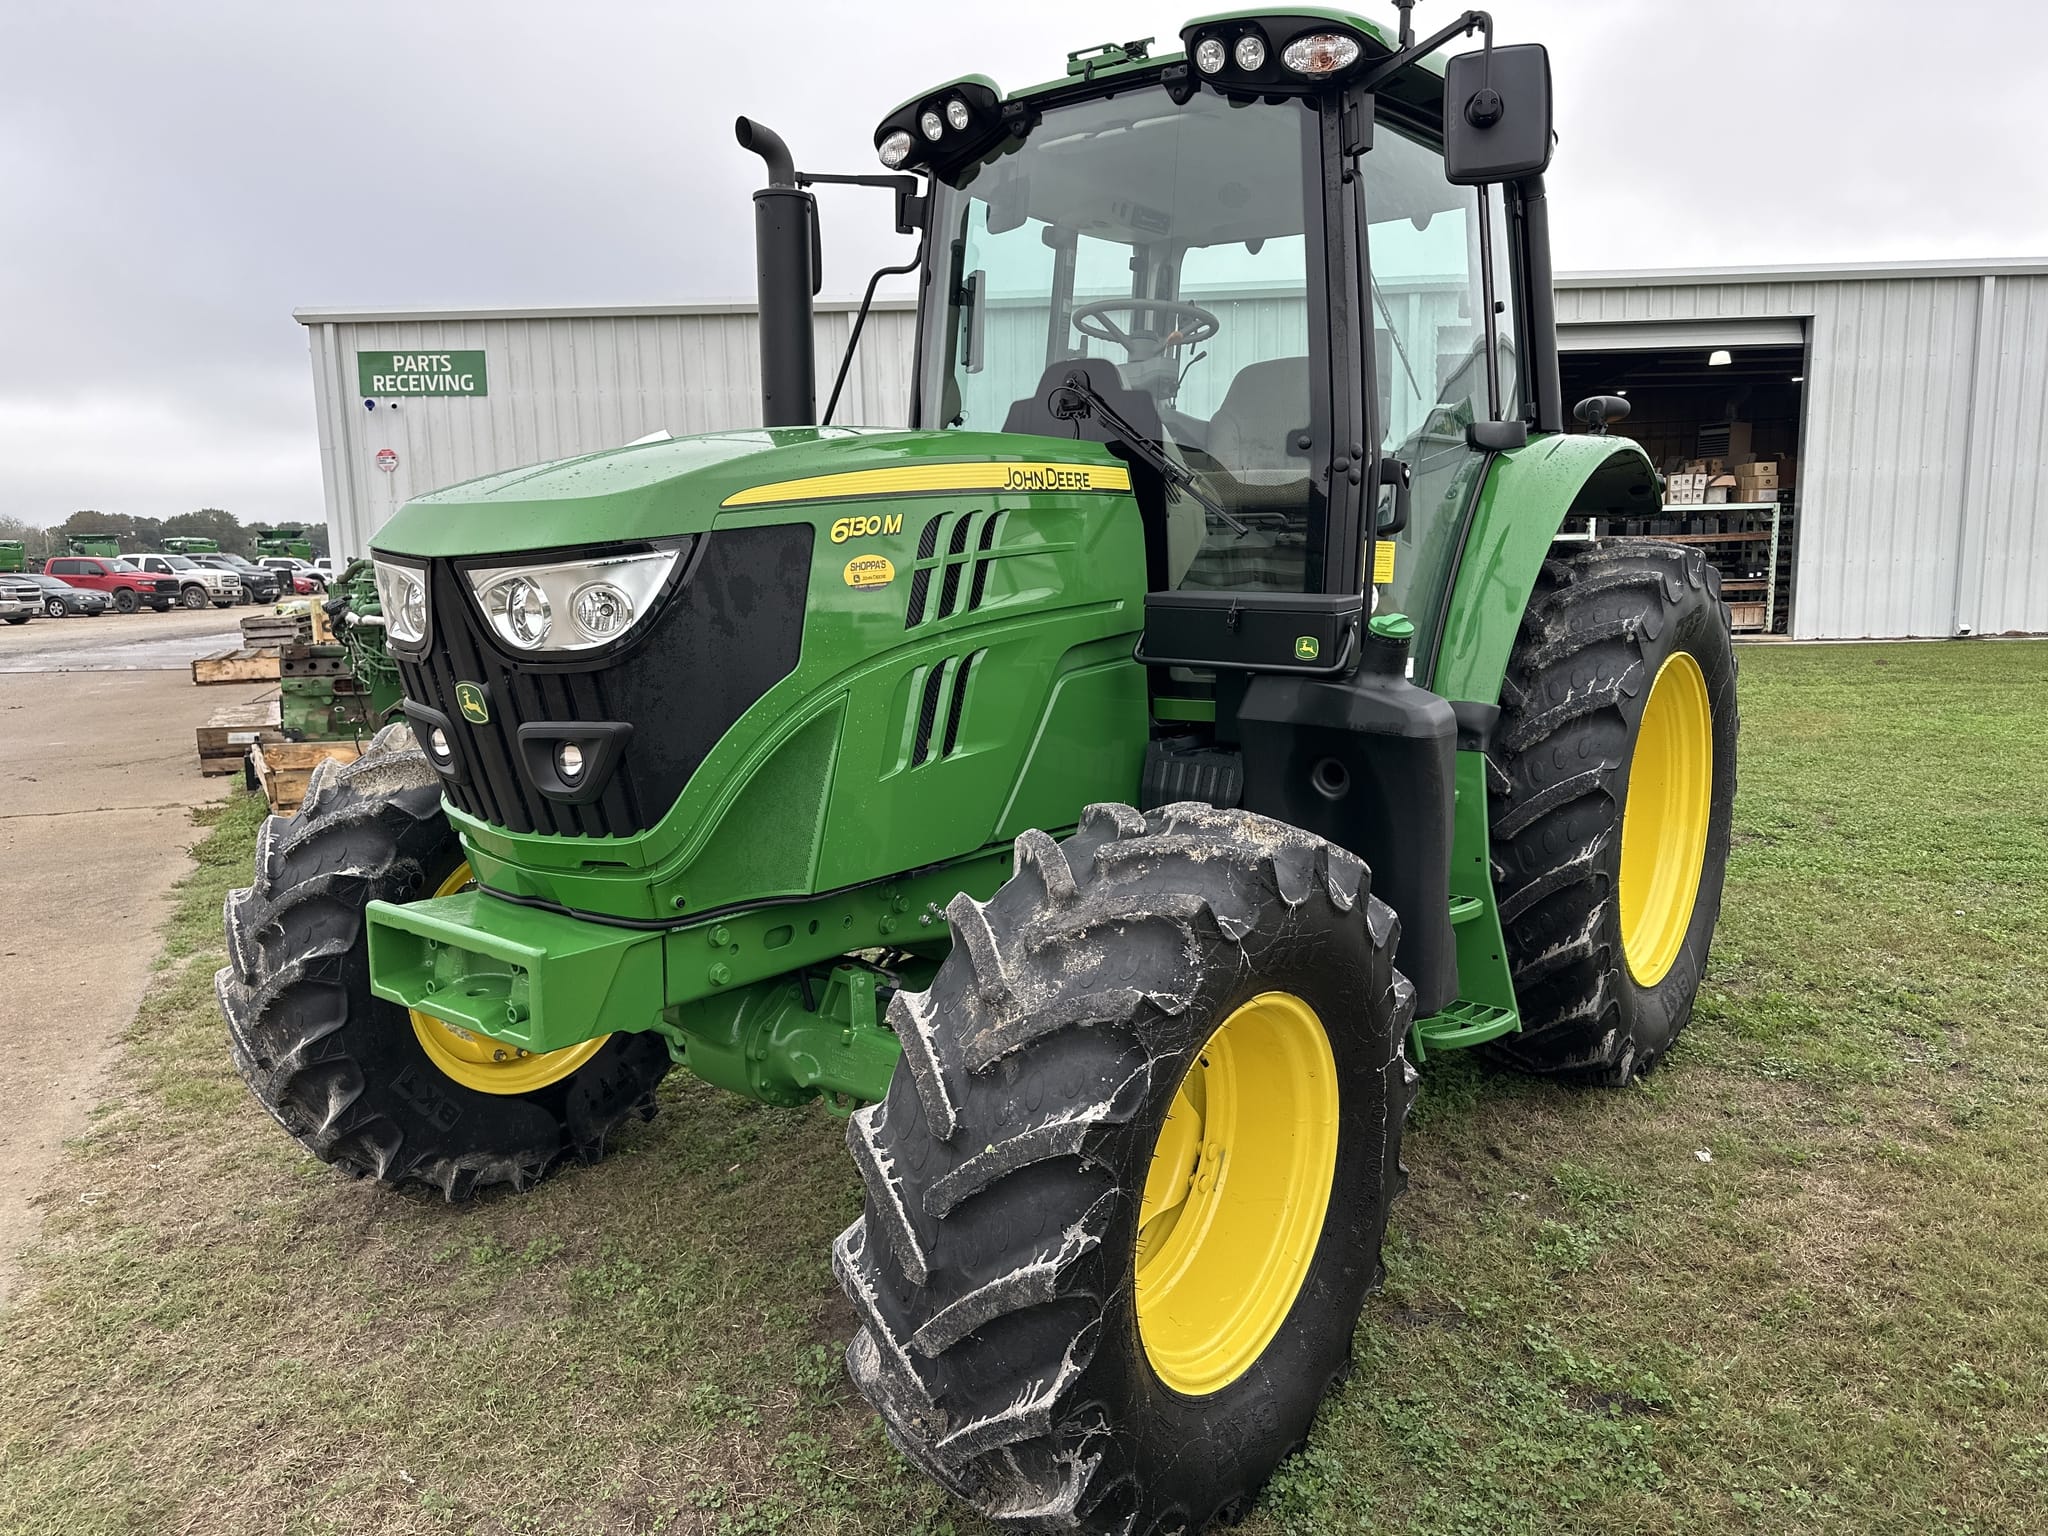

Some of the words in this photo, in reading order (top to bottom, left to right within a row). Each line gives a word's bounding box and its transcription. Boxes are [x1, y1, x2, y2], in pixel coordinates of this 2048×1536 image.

[393, 355, 452, 372] PARTS
[373, 374, 474, 391] RECEIVING
[1004, 467, 1045, 488] JOHN
[1046, 468, 1091, 489] DEERE
[850, 560, 886, 571] SHOPPA'S
